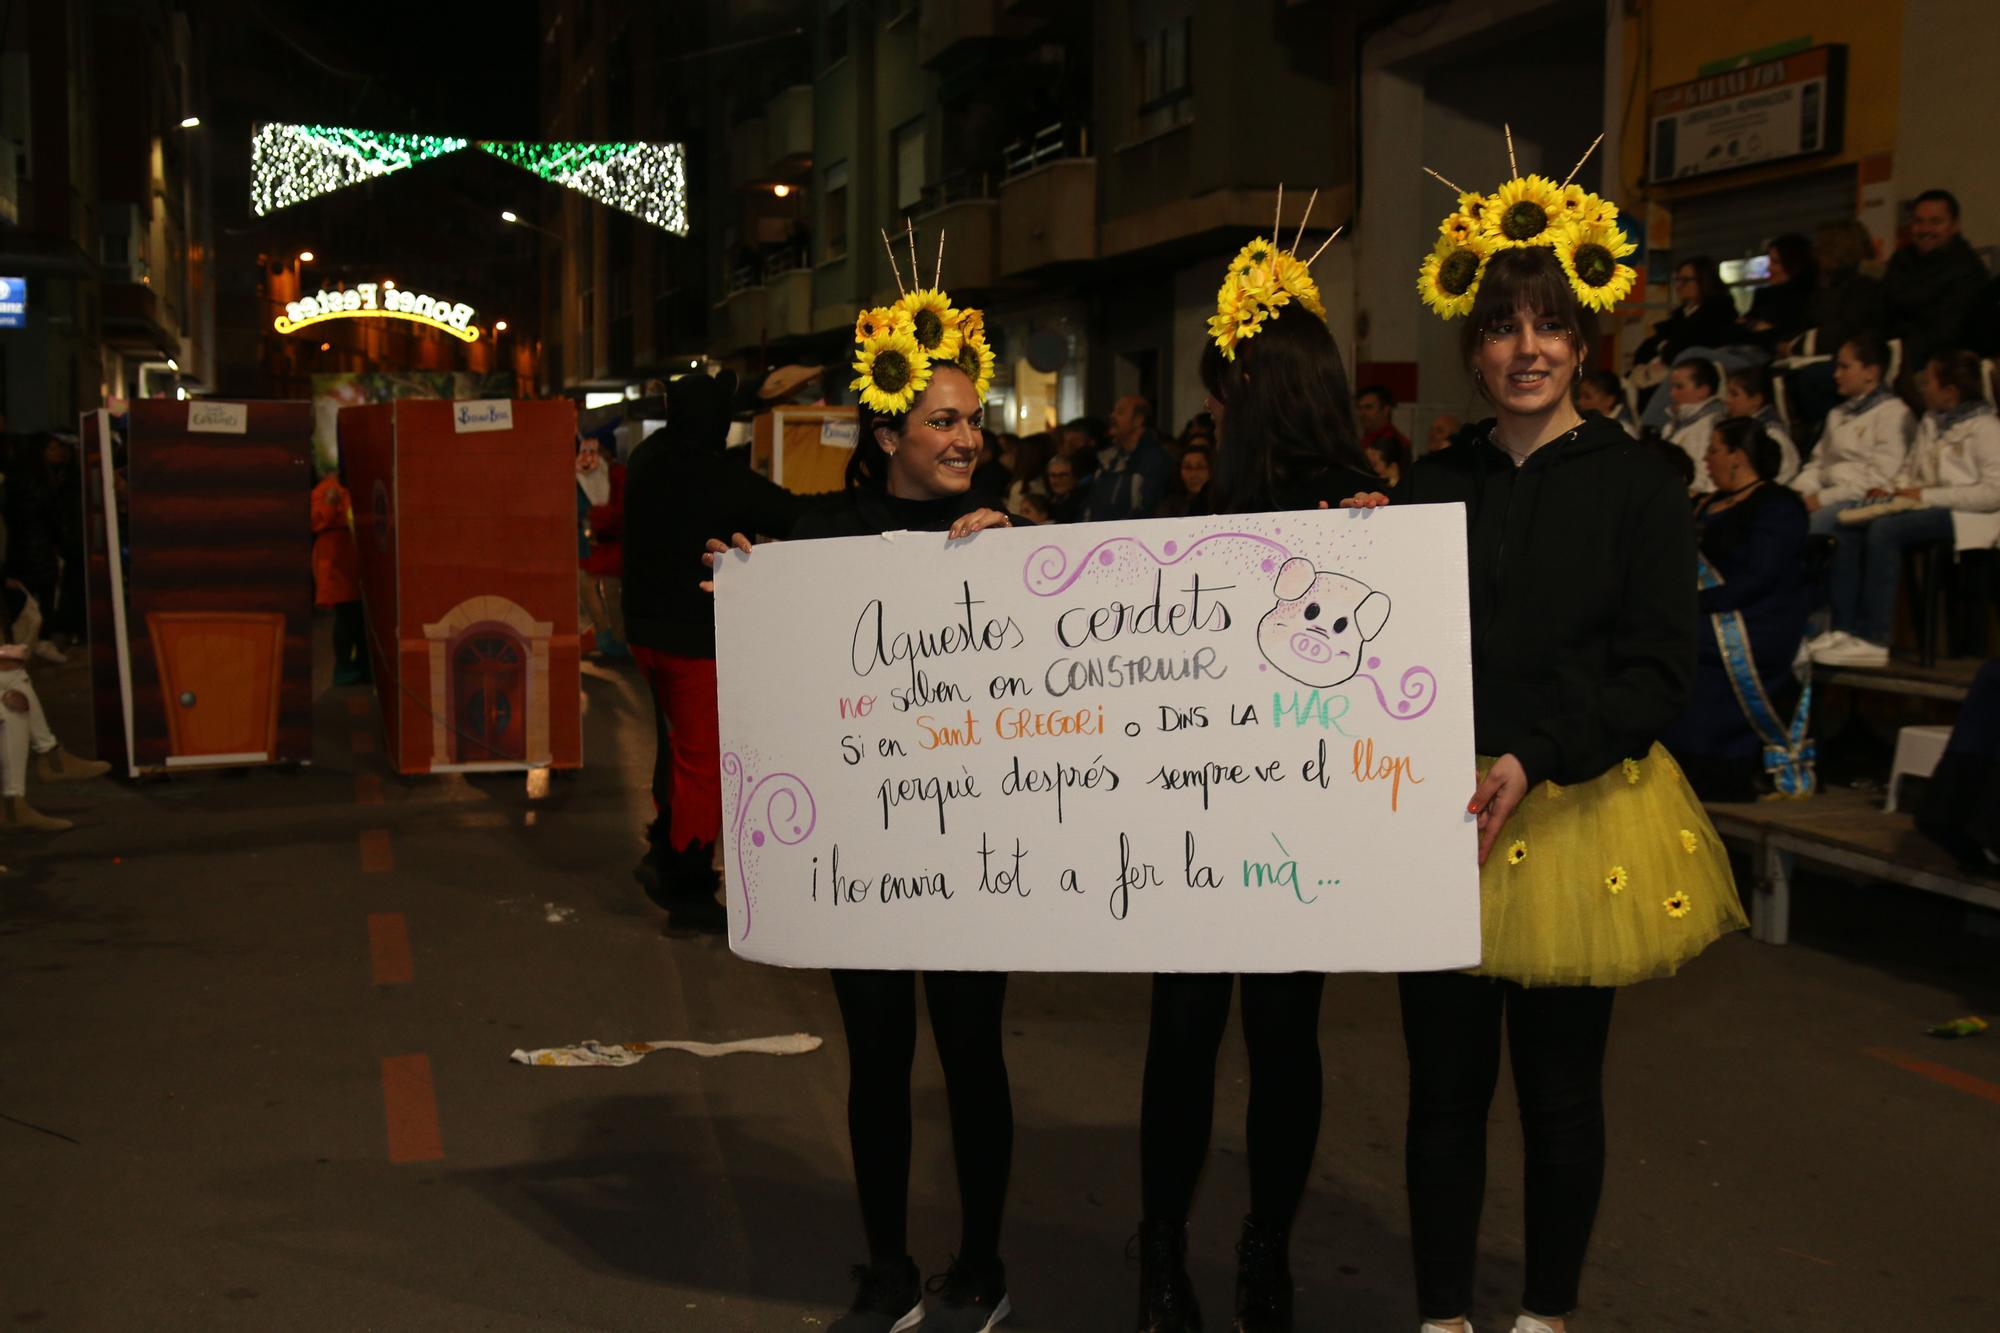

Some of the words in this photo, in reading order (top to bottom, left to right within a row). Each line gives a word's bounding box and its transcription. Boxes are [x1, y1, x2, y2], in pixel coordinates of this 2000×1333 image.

[851, 580, 1024, 677] Aquestos
[1056, 568, 1236, 649] cerdets
[839, 694, 877, 720] no
[890, 668, 971, 713] saben
[988, 674, 1033, 700] on
[840, 736, 866, 766] Si
[877, 737, 908, 757] en
[916, 709, 982, 751] Sant
[1124, 721, 1142, 738] o
[1230, 704, 1260, 726] LA
[1271, 690, 1356, 737] MAR
[876, 765, 982, 836] perquè
[1000, 755, 1121, 824] després
[1146, 760, 1251, 811] sempre
[1256, 760, 1286, 782] ve
[1301, 738, 1331, 790] el
[1350, 737, 1426, 813] llop
[832, 843, 873, 906] ho
[879, 868, 955, 904] envia
[976, 831, 1032, 898] tot
[1060, 868, 1086, 894] a
[1109, 831, 1164, 920] fer
[1184, 830, 1224, 890] la
